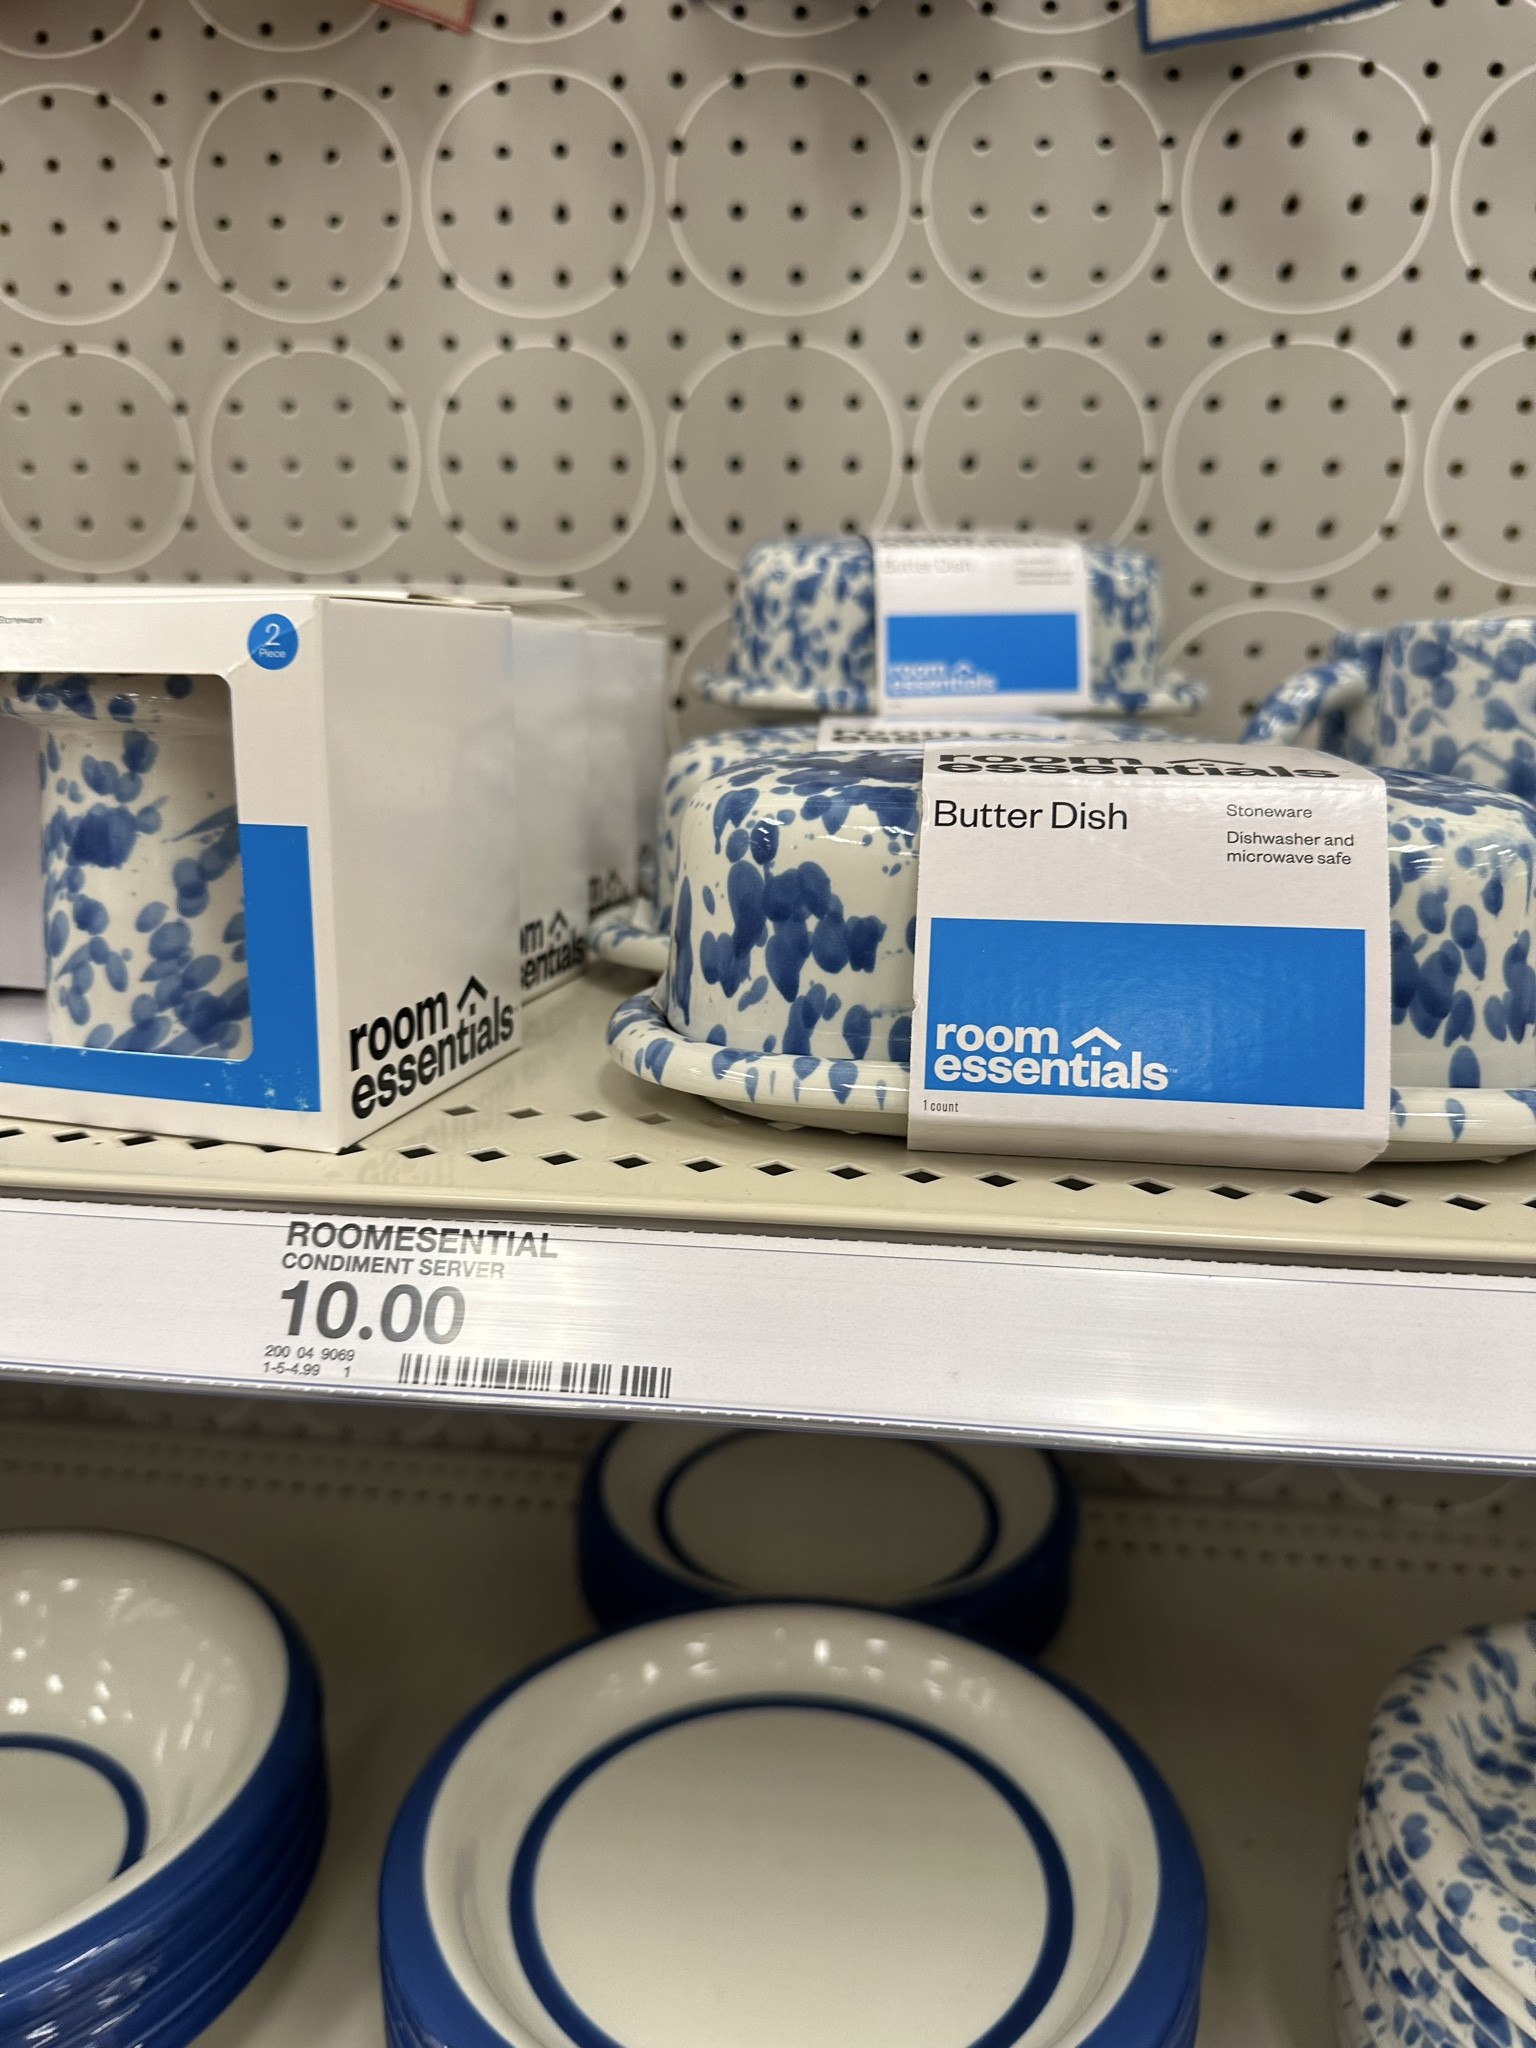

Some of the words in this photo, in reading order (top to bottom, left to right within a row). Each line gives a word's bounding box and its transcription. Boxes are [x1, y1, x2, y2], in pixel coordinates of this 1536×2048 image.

[264, 622, 281, 646] 2
[258, 647, 287, 659] Piece
[937, 762, 1340, 778] essentials
[939, 754, 1143, 766] room
[933, 799, 1043, 829] Butter
[1051, 801, 1128, 831] Dish
[1226, 803, 1313, 819] Stoneware
[1226, 830, 1321, 847] Dishwasher
[1323, 833, 1355, 847] and
[1226, 849, 1314, 864] microwave
[1316, 851, 1352, 865] safe
[349, 991, 449, 1072] room
[935, 1023, 1059, 1055] room
[351, 995, 515, 1120] essentials
[933, 1046, 1170, 1092] essentials
[922, 1099, 928, 1112] 1
[929, 1101, 959, 1114] count
[286, 1220, 559, 1259] ROOMESENTIAL
[281, 1252, 415, 1276] CONDIMENT
[418, 1257, 505, 1280] SERVER
[280, 1279, 467, 1345] 10.00
[264, 1344, 291, 1359] 200
[296, 1346, 315, 1359] 04
[320, 1347, 356, 1362] 9069
[263, 1361, 321, 1377] 1-5-4.99
[343, 1365, 352, 1378] 1
